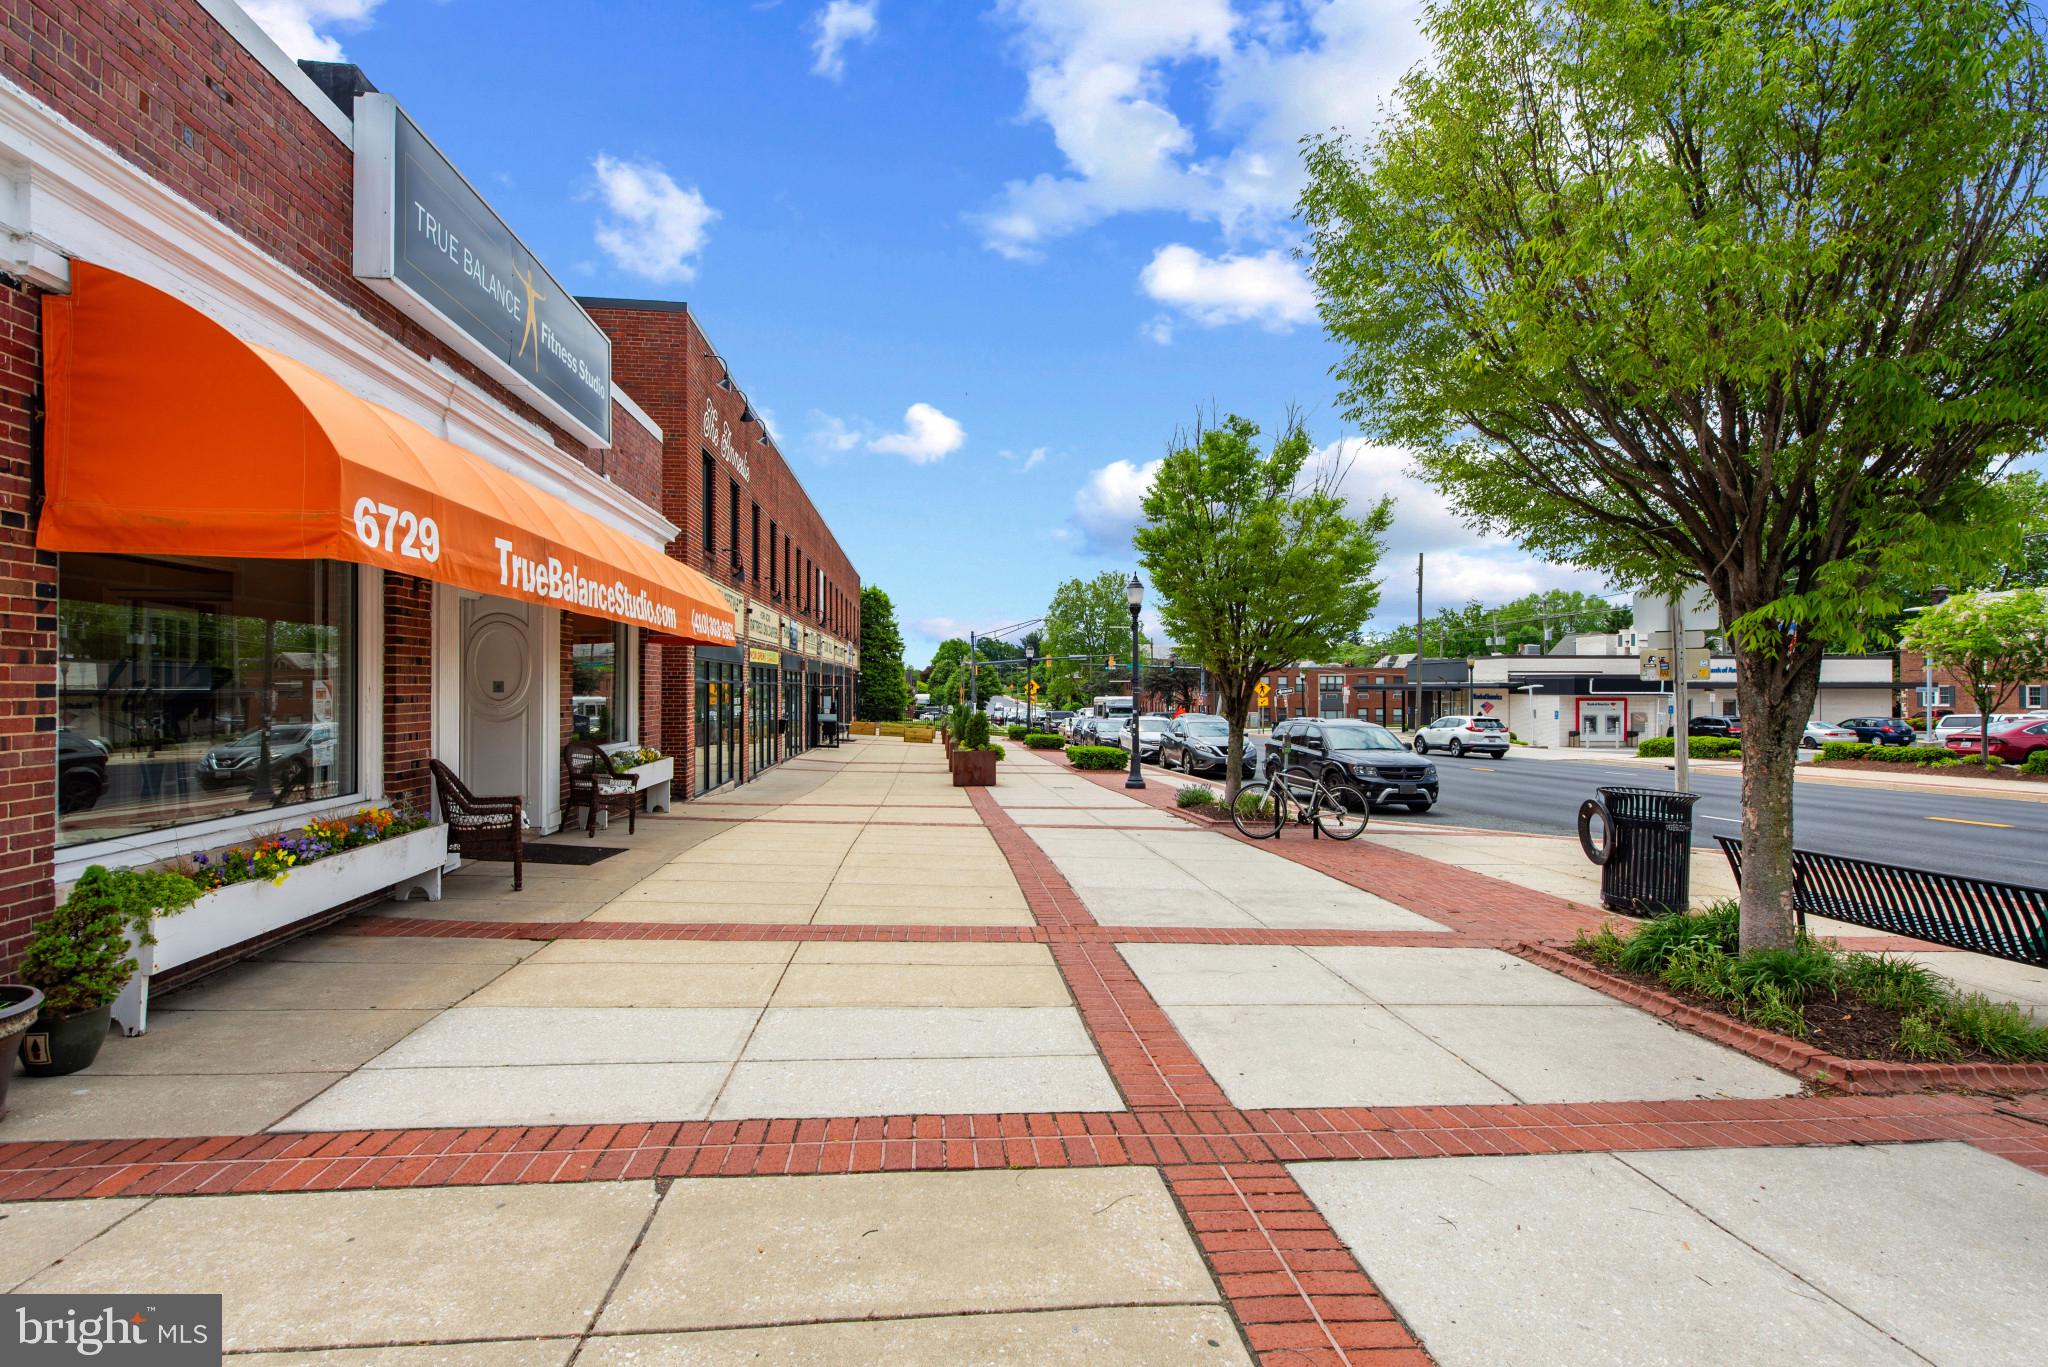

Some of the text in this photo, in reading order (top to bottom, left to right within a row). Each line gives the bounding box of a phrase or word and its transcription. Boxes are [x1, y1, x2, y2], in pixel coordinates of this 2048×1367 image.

[414, 200, 521, 322] TRUE BALANCE
[540, 319, 606, 400] Fitness Studio
[703, 397, 719, 447] The
[353, 496, 440, 563] 6729
[494, 537, 677, 630] TrueBalanceStudio.com
